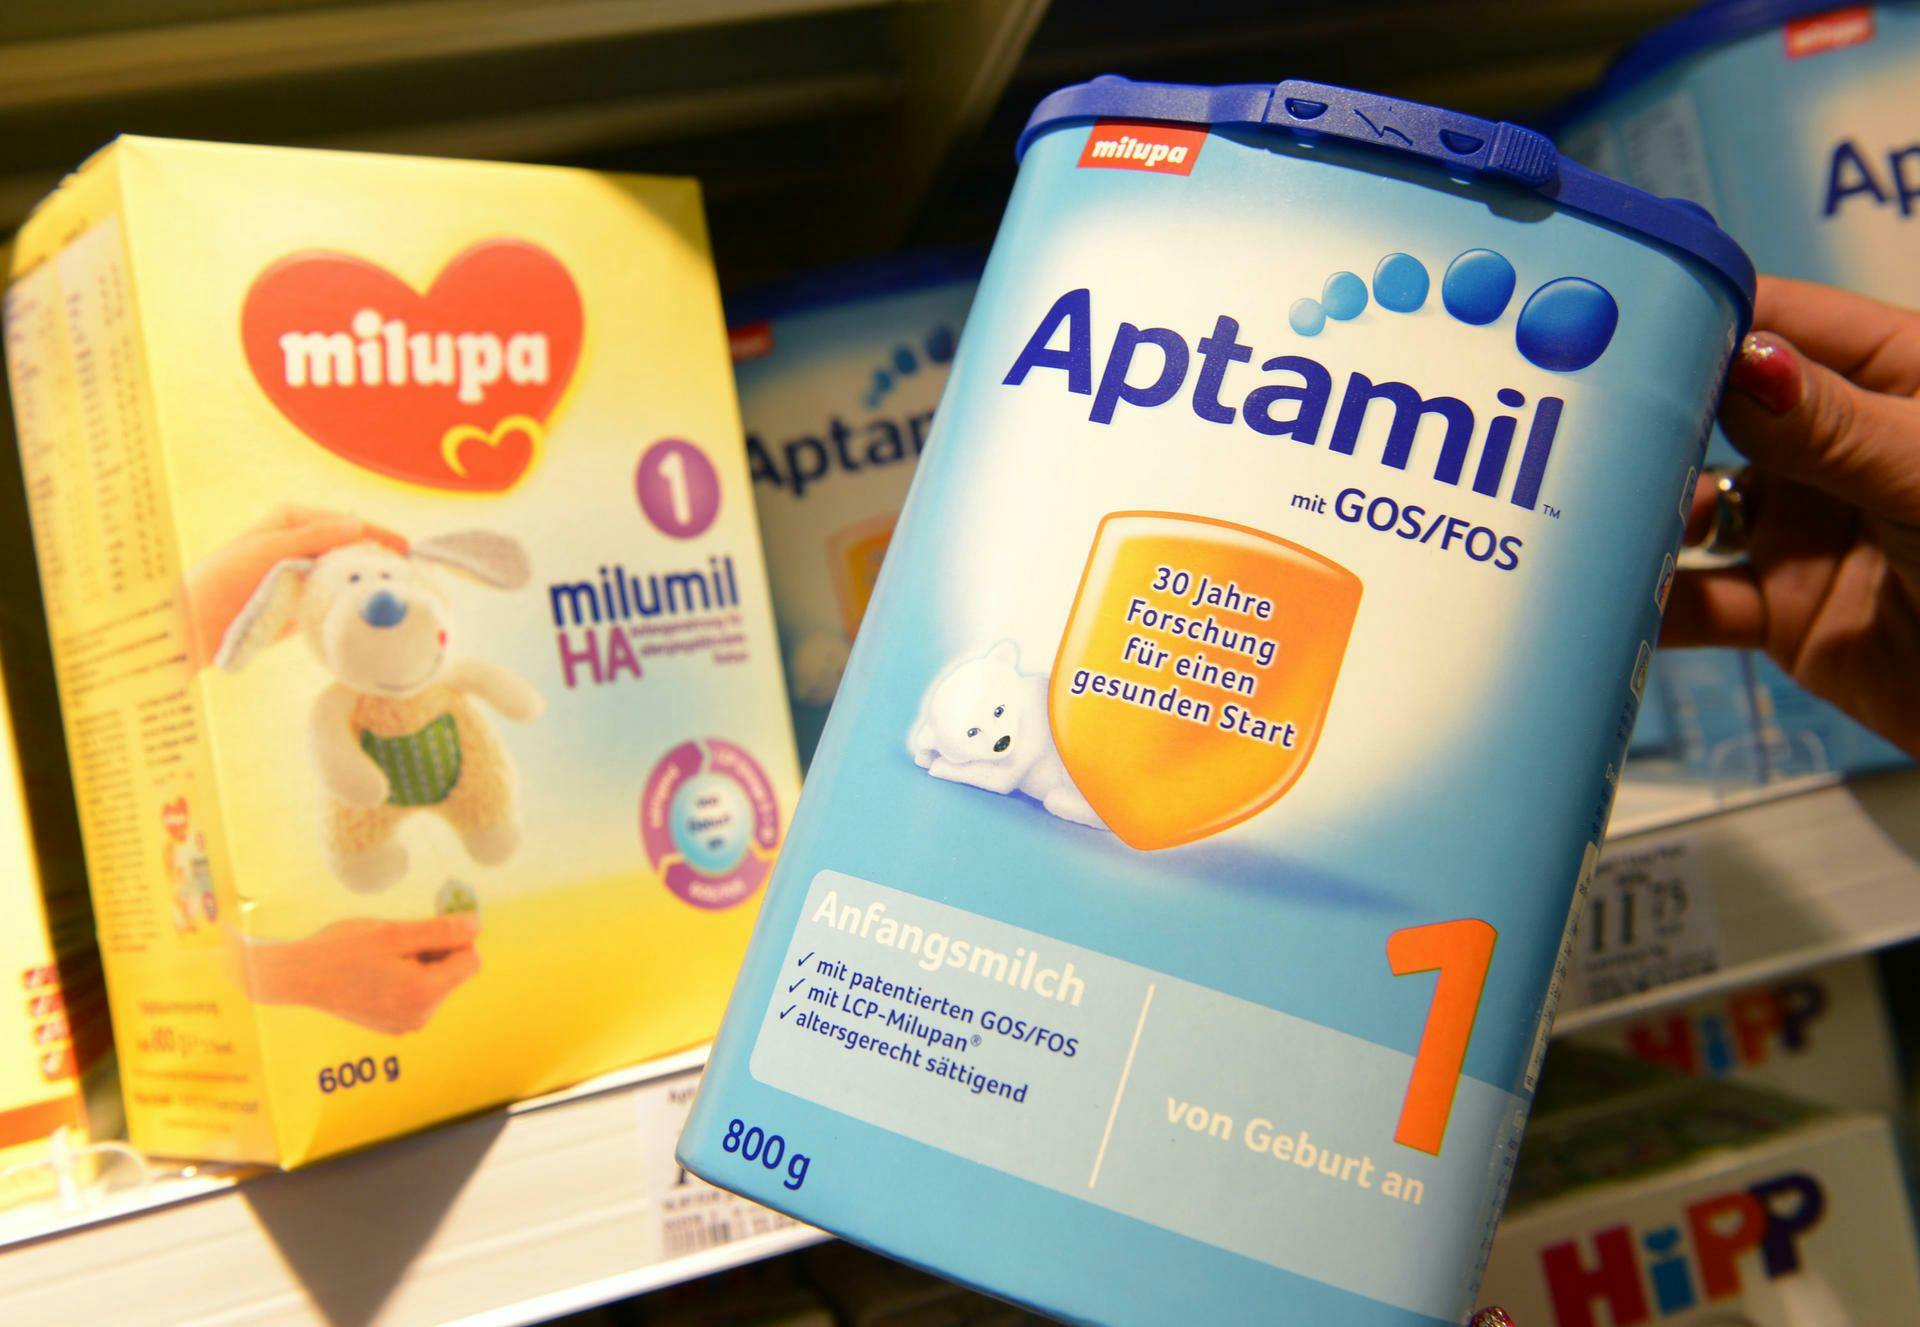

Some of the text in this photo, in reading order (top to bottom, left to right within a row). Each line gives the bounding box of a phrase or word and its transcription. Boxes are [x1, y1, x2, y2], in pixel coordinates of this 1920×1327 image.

[1091, 136, 1188, 167] milupa
[280, 308, 549, 403] milupa
[1002, 287, 1564, 512] Aptamil
[657, 449, 694, 527] 1
[1290, 487, 1524, 571] mit GOS/FOS
[550, 556, 740, 627] milumil
[1152, 566, 1273, 619] 30 Jahre
[558, 625, 643, 689] HA
[1123, 636, 1256, 695] für einen
[1126, 598, 1277, 666] Forschung
[1070, 669, 1296, 748] gesunden Start
[810, 890, 1086, 1007] Anfangsmilch
[807, 985, 838, 1008] mit
[816, 959, 1079, 1058] mit patentierten GOS/FOS
[319, 1055, 401, 1095] 600 g
[795, 1009, 1029, 1104] altersgerecht sättigend
[1385, 918, 1498, 1157] 1
[722, 1118, 811, 1191] 800 g
[1167, 1097, 1425, 1205] von Geburt an
